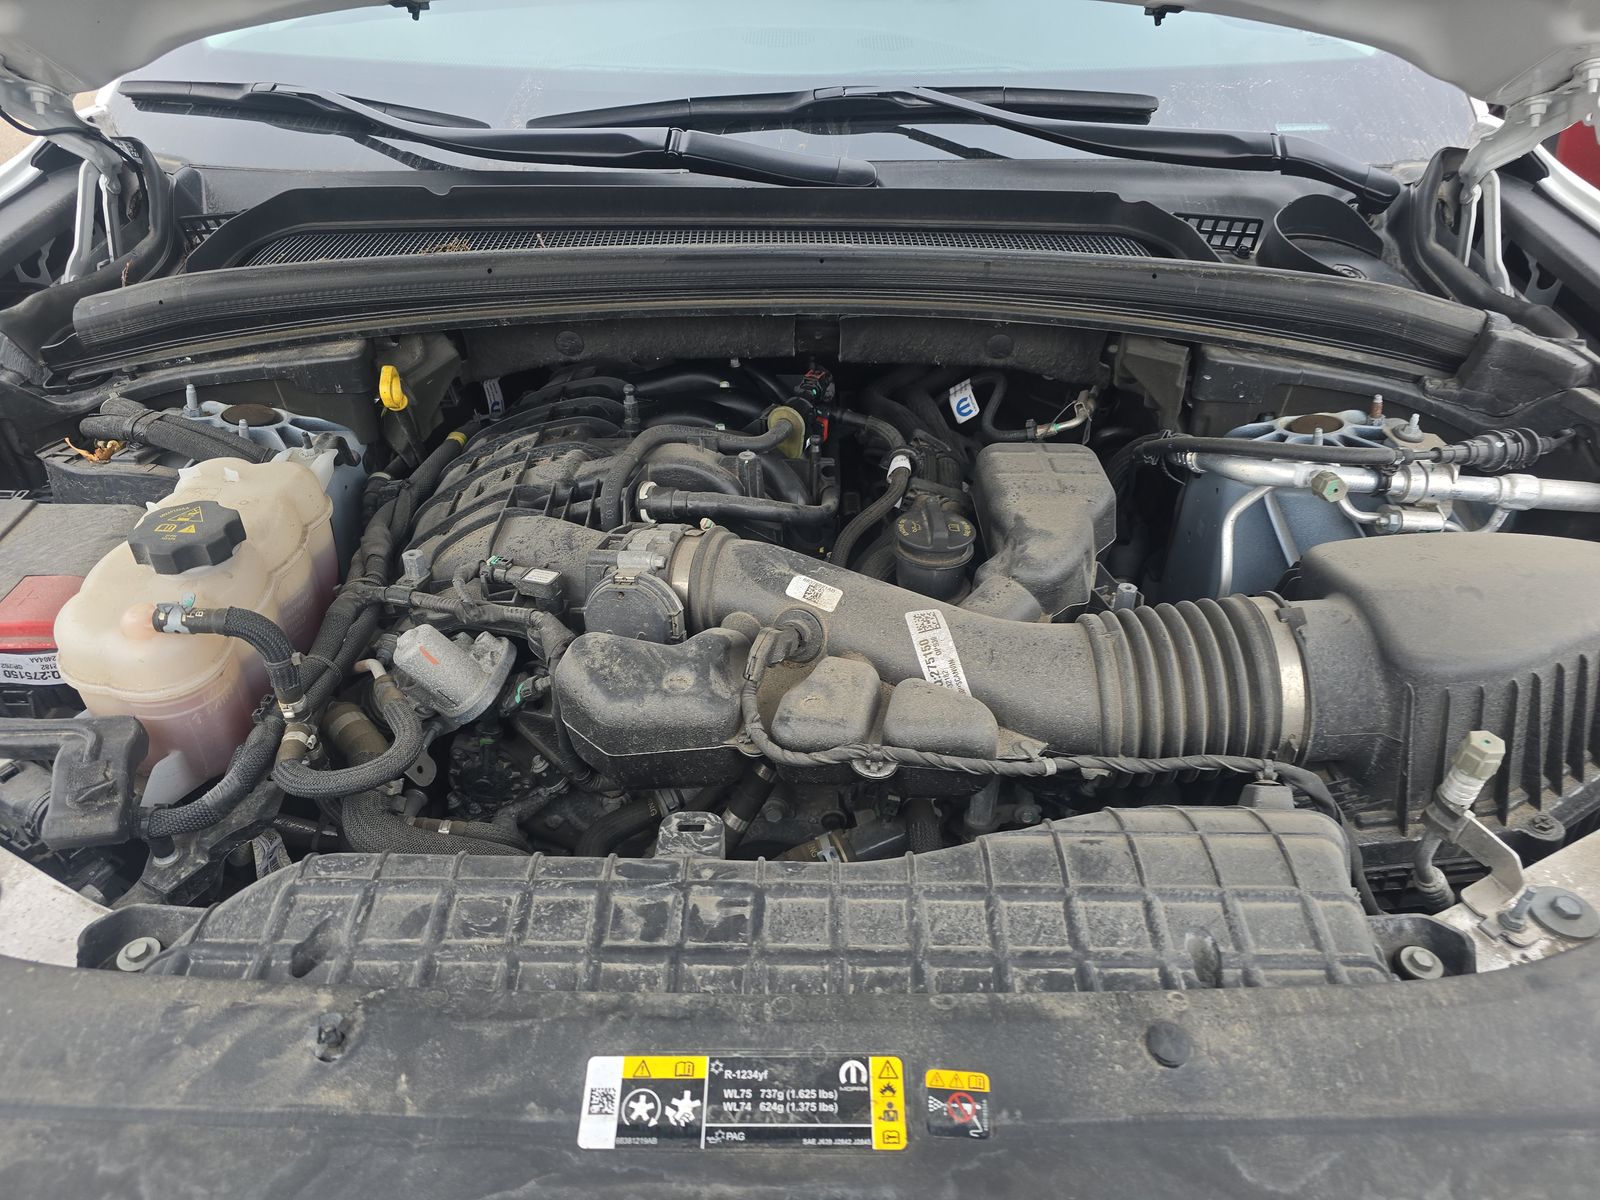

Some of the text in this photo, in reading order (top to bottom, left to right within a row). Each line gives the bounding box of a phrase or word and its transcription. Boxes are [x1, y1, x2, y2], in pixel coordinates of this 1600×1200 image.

[3, 669, 61, 680] Q:275150
[724, 1069, 769, 1082] R-1234yf
[723, 1088, 838, 1100] WL75 737g (1.625 lbs)
[722, 1102, 839, 1113] WL74 624g (1.375 lbs)
[725, 1131, 746, 1141] PAG
